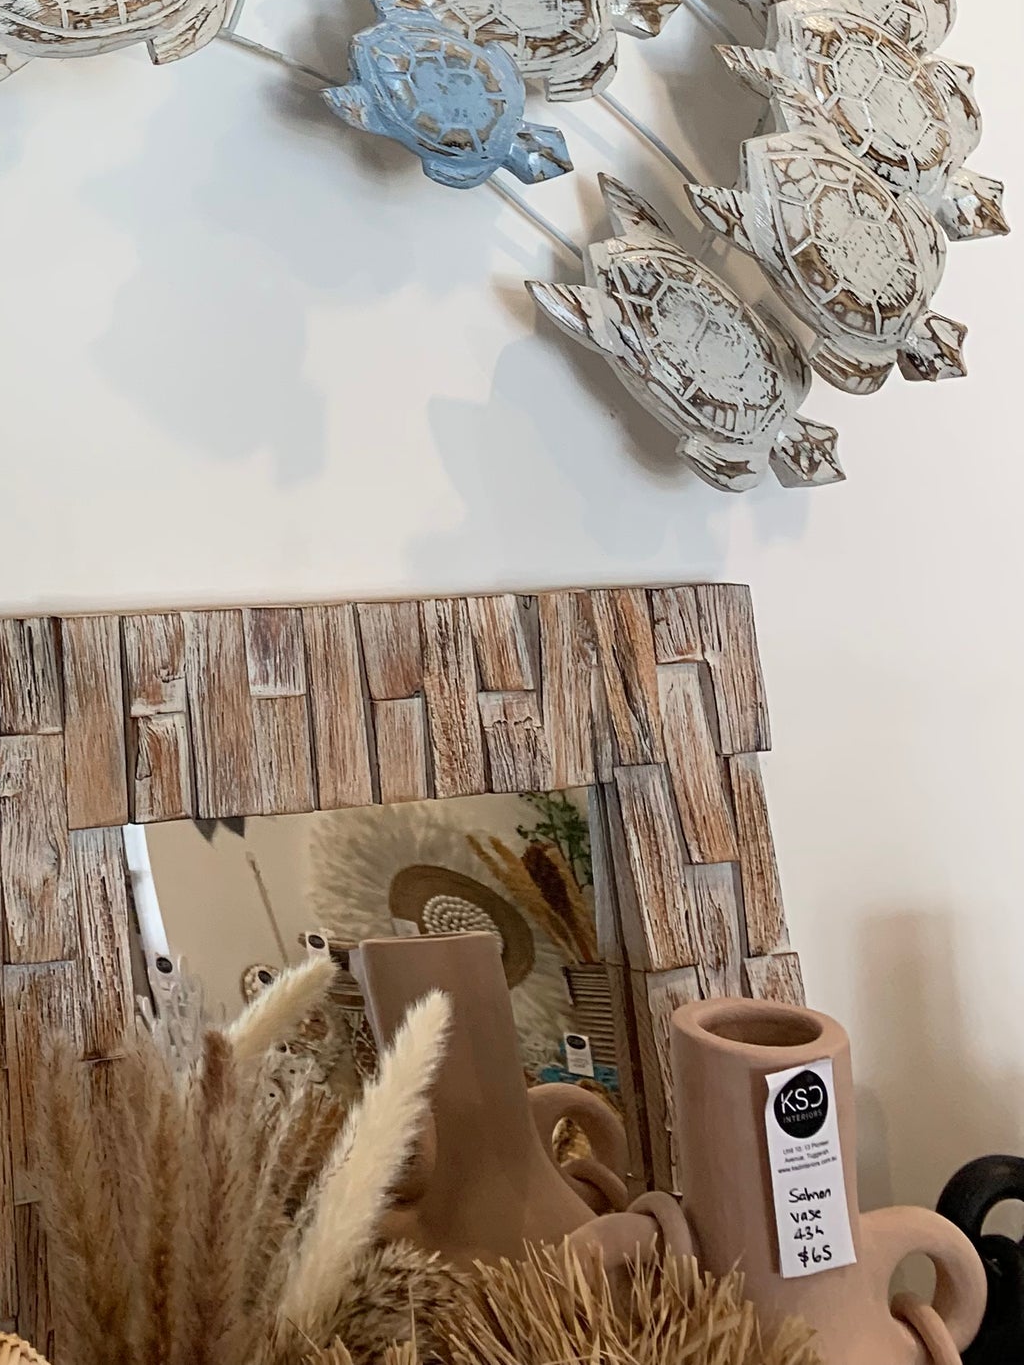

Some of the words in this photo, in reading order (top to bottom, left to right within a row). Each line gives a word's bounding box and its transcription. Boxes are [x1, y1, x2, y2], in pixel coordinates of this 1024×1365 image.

[781, 1085, 824, 1114] KSD
[783, 1109, 823, 1124] INTERIORS
[788, 1187, 832, 1204] Salmon
[797, 1245, 833, 1268] $65
